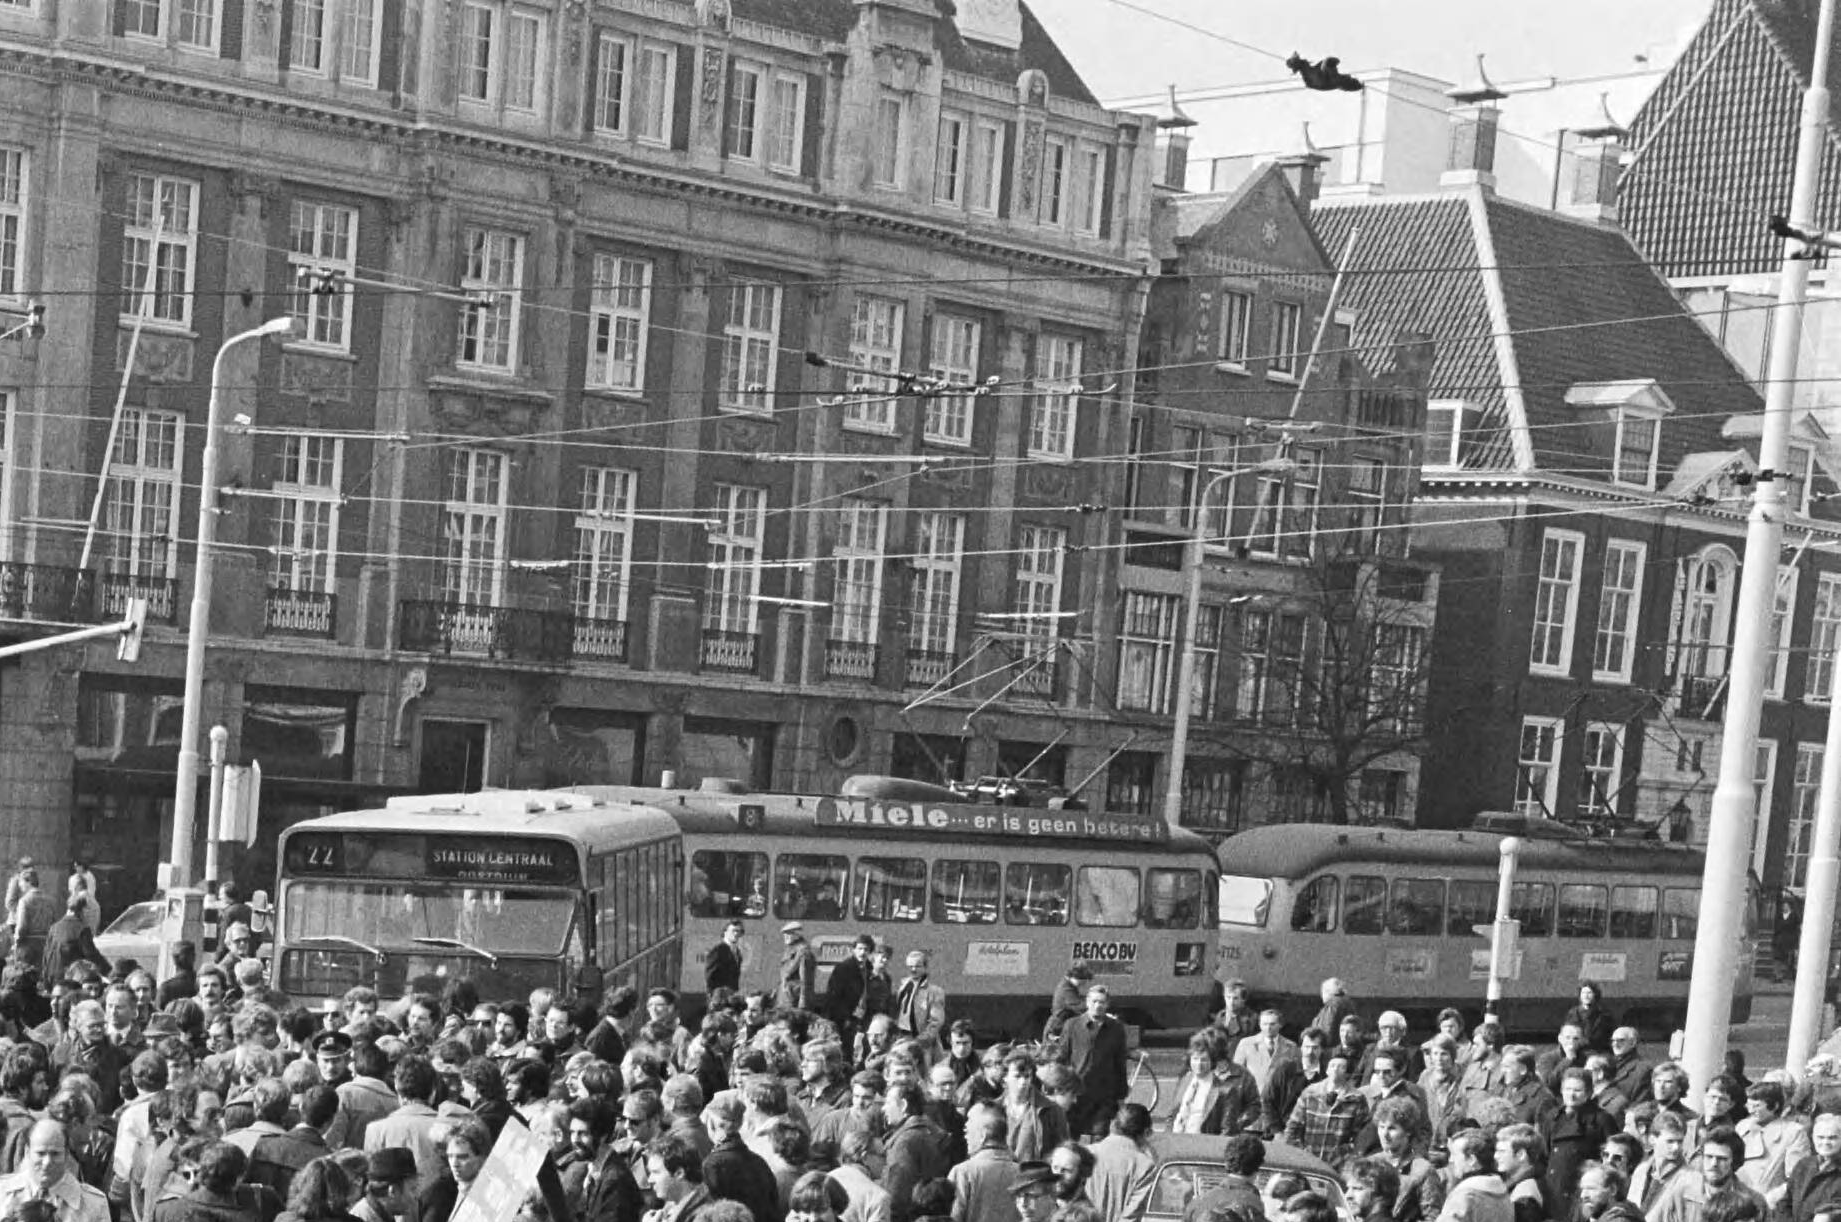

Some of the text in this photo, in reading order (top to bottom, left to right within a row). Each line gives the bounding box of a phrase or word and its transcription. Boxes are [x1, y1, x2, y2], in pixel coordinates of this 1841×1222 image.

[745, 807, 756, 827] 8
[974, 814, 997, 829] er
[1003, 813, 1021, 831] is
[1029, 817, 1077, 835] geen
[307, 845, 334, 865] 22
[433, 849, 486, 865] STATION
